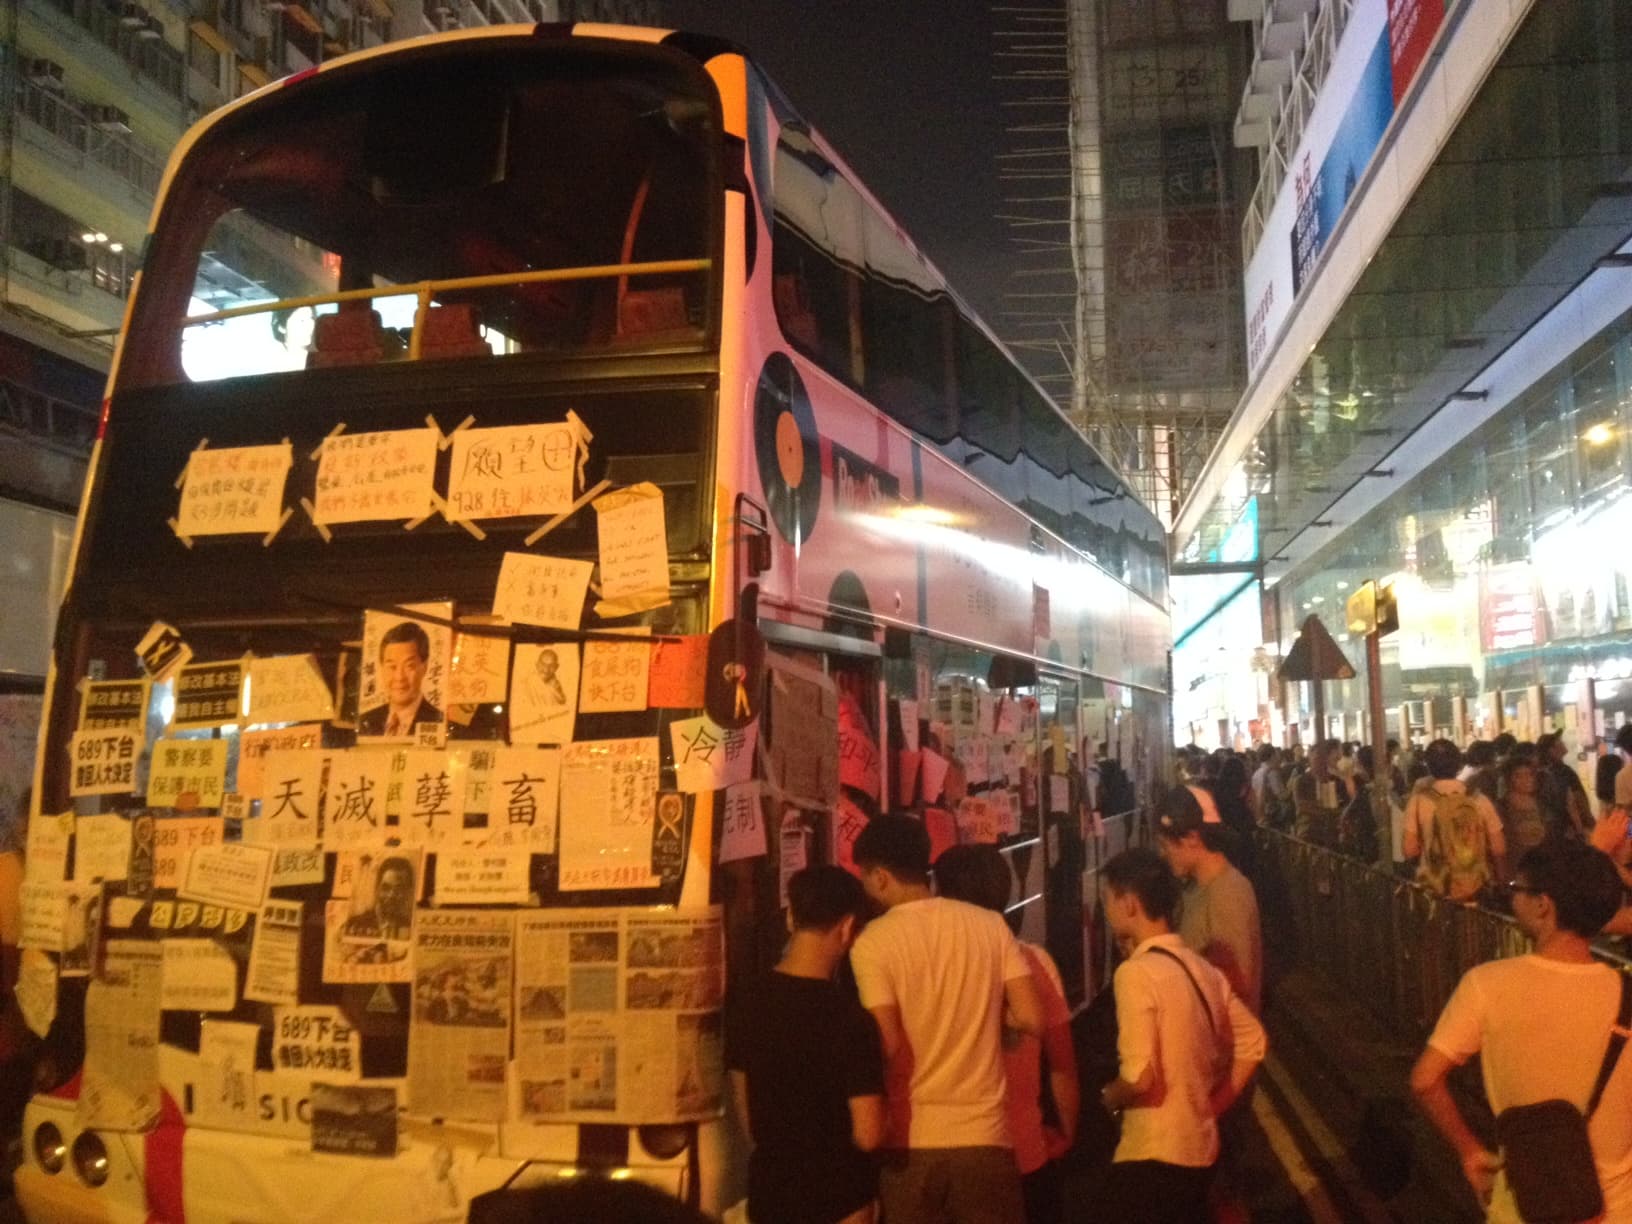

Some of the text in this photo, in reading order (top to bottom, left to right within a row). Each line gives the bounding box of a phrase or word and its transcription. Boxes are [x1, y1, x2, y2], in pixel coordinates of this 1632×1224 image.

[78, 737, 135, 761] 689下台
[165, 747, 214, 767] 警察要
[152, 776, 219, 796] 保護市民
[271, 771, 546, 828] 天滅孽畜
[281, 1015, 351, 1043] 689下台
